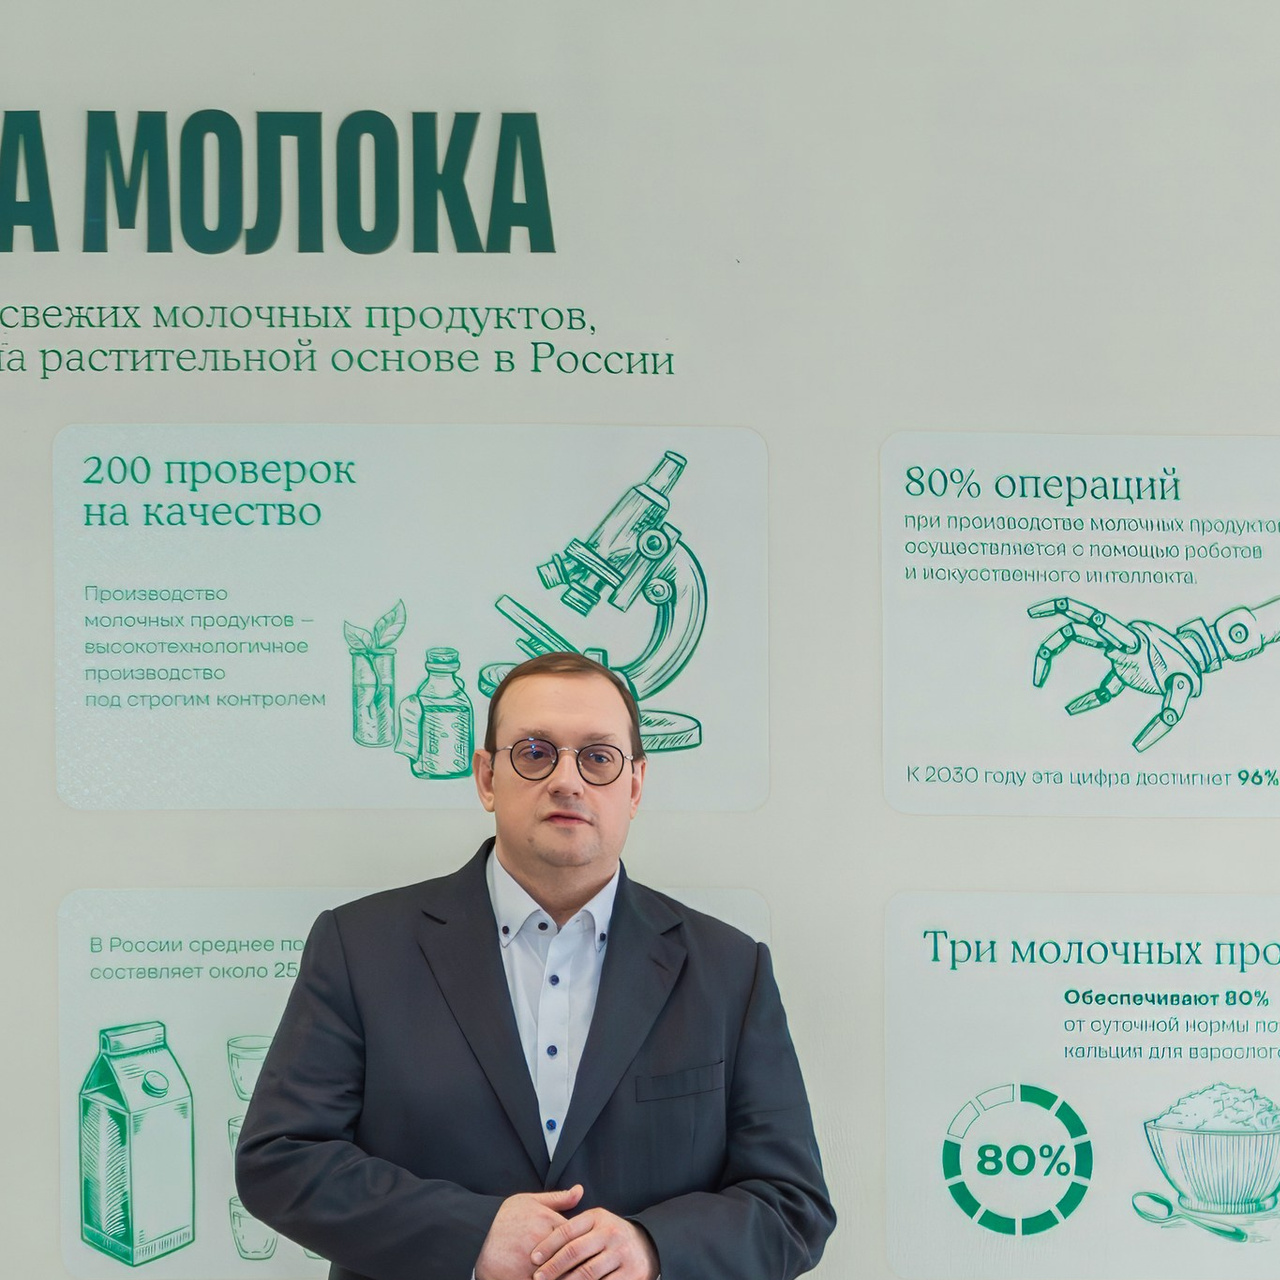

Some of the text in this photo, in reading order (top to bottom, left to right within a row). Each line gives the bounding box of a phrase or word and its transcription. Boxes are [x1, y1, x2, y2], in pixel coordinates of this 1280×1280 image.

[81, 108, 557, 256] МОЛОКА
[0, 305, 142, 329] свежих
[152, 305, 352, 329] молочных
[364, 306, 596, 338] продуктов,
[38, 338, 317, 380] растительной
[330, 348, 480, 373] основе
[494, 350, 515, 373] в
[530, 341, 675, 375] России
[82, 455, 357, 493] 200 проверок
[905, 465, 1181, 508] 80% операций
[83, 502, 322, 527] на качество
[904, 514, 1280, 537] при молочных продукто
[1071, 543, 1084, 557] с
[1089, 543, 1180, 560] помощью
[1184, 541, 1263, 561] роботов
[904, 566, 917, 580] и
[84, 585, 228, 604] Производство
[84, 614, 295, 631] молочных продуктов
[84, 640, 309, 655] высокотехнологичное
[84, 667, 226, 684] производство
[85, 693, 326, 711] под строгим контролем
[907, 765, 920, 782] К
[925, 765, 979, 784] 2030
[984, 770, 1027, 787] году
[1069, 768, 1130, 788] цифра
[1237, 768, 1280, 787] 96%
[89, 936, 103, 954] В
[109, 936, 183, 953] России
[188, 939, 275, 956] среднее
[922, 929, 1280, 974] Три молочных про
[90, 961, 298, 980] составляет около 25
[1063, 988, 1270, 1007] Обеспечивают 80%
[1063, 1016, 1249, 1037] от суточной нормы
[1064, 1045, 1183, 1060] кальция для
[976, 1143, 1071, 1177] 80%
